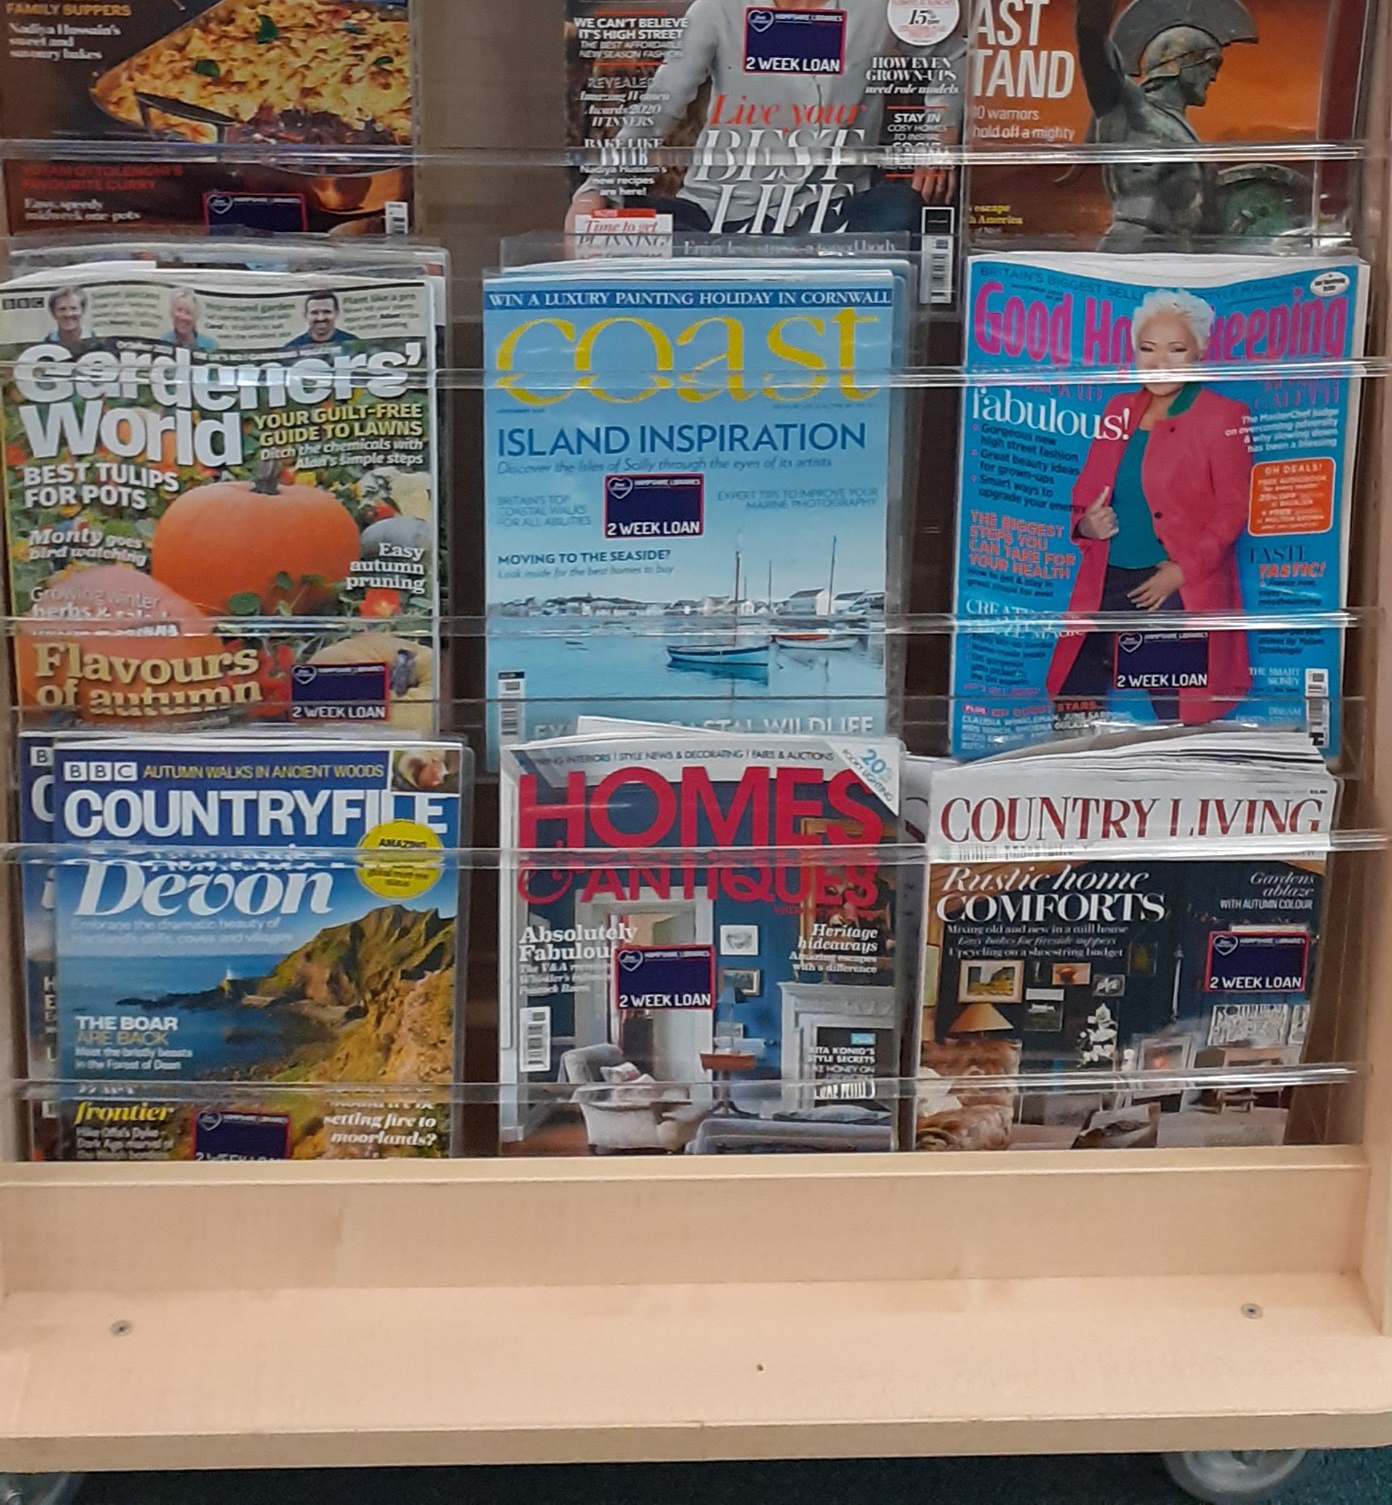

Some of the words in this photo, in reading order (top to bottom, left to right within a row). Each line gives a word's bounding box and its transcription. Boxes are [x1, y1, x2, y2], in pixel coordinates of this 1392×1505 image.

[574, 17, 595, 28] WE
[597, 18, 637, 28] CAN'T
[639, 17, 688, 28] BELIEVE
[579, 29, 600, 39] IT'S
[603, 29, 636, 39] HIGH
[639, 29, 683, 39] STREET
[746, 57, 755, 70] 2
[758, 57, 800, 71] WEEK
[803, 58, 840, 72] LOAN
[694, 129, 865, 182] BEST
[708, 183, 854, 234] LIFE
[2, 297, 44, 310] BBC
[490, 294, 525, 306] WIN
[528, 294, 540, 306] A
[545, 293, 608, 306] LUXURY
[616, 293, 694, 306] PAINTING
[700, 292, 773, 305] HOLIDAY
[778, 292, 797, 305] IN
[801, 291, 891, 304] CORNWALL
[974, 282, 1074, 367] Good
[1083, 289, 1350, 368] Hokeeping
[496, 307, 880, 406] coast
[13, 342, 422, 412] Gardeners'
[254, 410, 308, 431] YOUR
[312, 404, 423, 423] GUILT-FREE
[972, 386, 1131, 441] fabulous!
[19, 399, 244, 468] World
[259, 427, 319, 448] GUIDE
[323, 425, 347, 439] TO
[350, 421, 423, 437] LAWNS
[498, 426, 631, 456] ISLAND
[641, 422, 866, 453] INSPIRATION
[261, 446, 295, 461] Ditch
[298, 444, 320, 457] the
[322, 441, 390, 454] chemicals
[393, 438, 423, 451] with
[296, 456, 336, 470] Alan's
[340, 454, 383, 469] simple
[386, 453, 423, 466] steps
[497, 461, 552, 475] Discover
[556, 462, 575, 474] the
[578, 461, 605, 473] Isles
[607, 460, 620, 473] of
[624, 459, 655, 474] Scilly
[659, 458, 706, 473] through
[709, 458, 730, 470] the
[733, 459, 760, 472] eyes
[763, 457, 777, 470] of
[778, 458, 792, 469] its
[797, 457, 832, 468] artists
[24, 462, 93, 487] BEST
[96, 463, 180, 493] TULIPS
[25, 487, 82, 510] FOR
[86, 488, 147, 511] POTS
[607, 523, 617, 536] 2
[620, 522, 661, 535] WEEK
[664, 522, 700, 535] LOAN
[379, 543, 424, 562] Easy
[498, 552, 554, 566] MOVING
[558, 552, 577, 564] TO
[580, 551, 606, 563] THE
[610, 549, 671, 562] SEASIDE?
[350, 560, 424, 574] autumn
[968, 553, 1008, 573] YOUR
[1010, 559, 1071, 581] HEALTH
[346, 575, 425, 594] pruning
[36, 643, 260, 686] Flavours
[1116, 675, 1126, 687] 2
[1128, 674, 1168, 687] WEEK
[1171, 674, 1208, 687] LOAN
[292, 707, 303, 718] 2
[305, 707, 346, 719] WEEK
[348, 707, 386, 718] LOAN
[64, 761, 138, 782] BBC
[143, 764, 203, 779] AUTUMN
[206, 765, 253, 779] WALKS
[255, 764, 269, 779] IN
[271, 764, 330, 779] ANCIENT
[333, 764, 384, 779] WOODS
[64, 790, 448, 838] COUNTRYFILE
[518, 766, 885, 849] HOMES
[940, 796, 1161, 843] COUNTRY
[1169, 797, 1324, 837] LIVING
[74, 858, 334, 917] Devon
[942, 864, 1048, 893] Rustic
[1050, 863, 1150, 892] home
[936, 894, 1167, 923] COMFORTS
[1219, 899, 1241, 910] WITH
[1243, 899, 1278, 910] AUTUMN
[1279, 899, 1313, 910] COLOUR
[518, 923, 639, 946] Absolutely
[811, 923, 879, 940] Heritage
[798, 936, 878, 954] hideaways
[1209, 977, 1219, 989] 2
[1221, 976, 1262, 989] WEEK
[1264, 977, 1301, 989] LOAN
[619, 994, 629, 1008] 2
[632, 994, 672, 1007] WEEK
[675, 994, 711, 1007] LOAN
[75, 1016, 117, 1031] THE
[120, 1016, 178, 1031] BOAR
